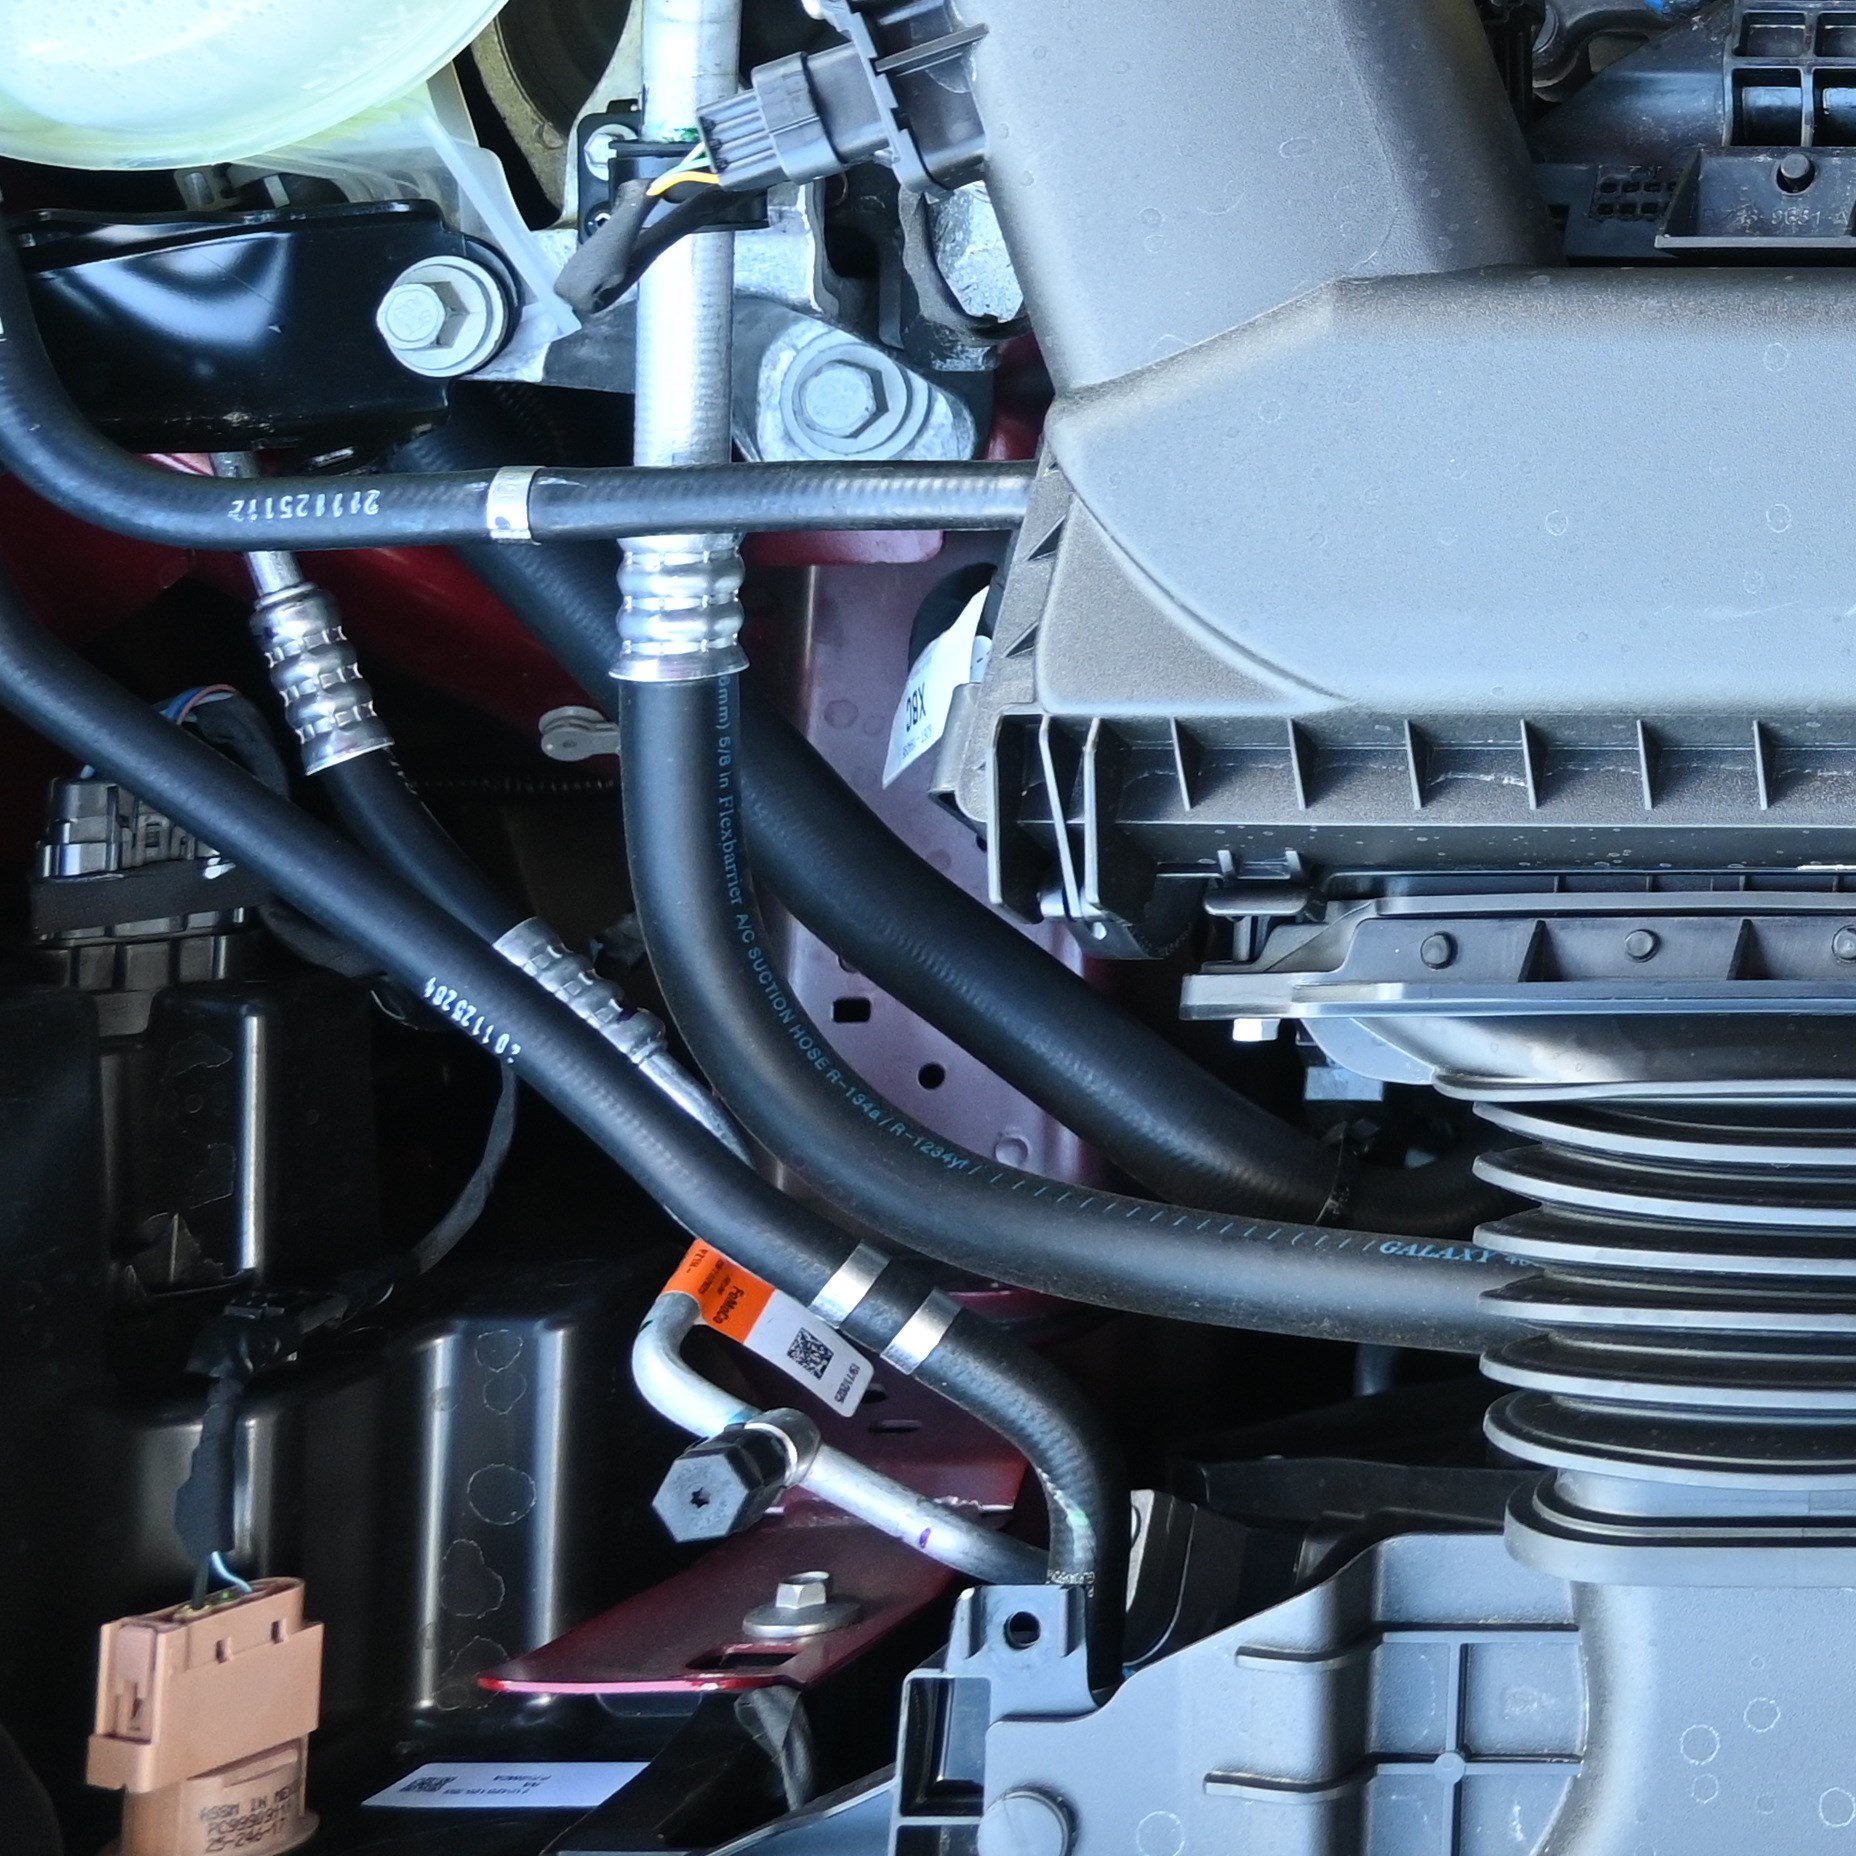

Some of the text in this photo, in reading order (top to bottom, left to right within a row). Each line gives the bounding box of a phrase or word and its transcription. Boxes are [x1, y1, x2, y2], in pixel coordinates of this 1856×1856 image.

[716, 736, 731, 766] 5/8
[716, 796, 742, 905] Flexbarrier
[746, 946, 796, 1025] SUCTION
[786, 1020, 832, 1073] HOSE
[1378, 1236, 1496, 1267] GALAXY
[712, 1283, 744, 1325] FoMoCo
